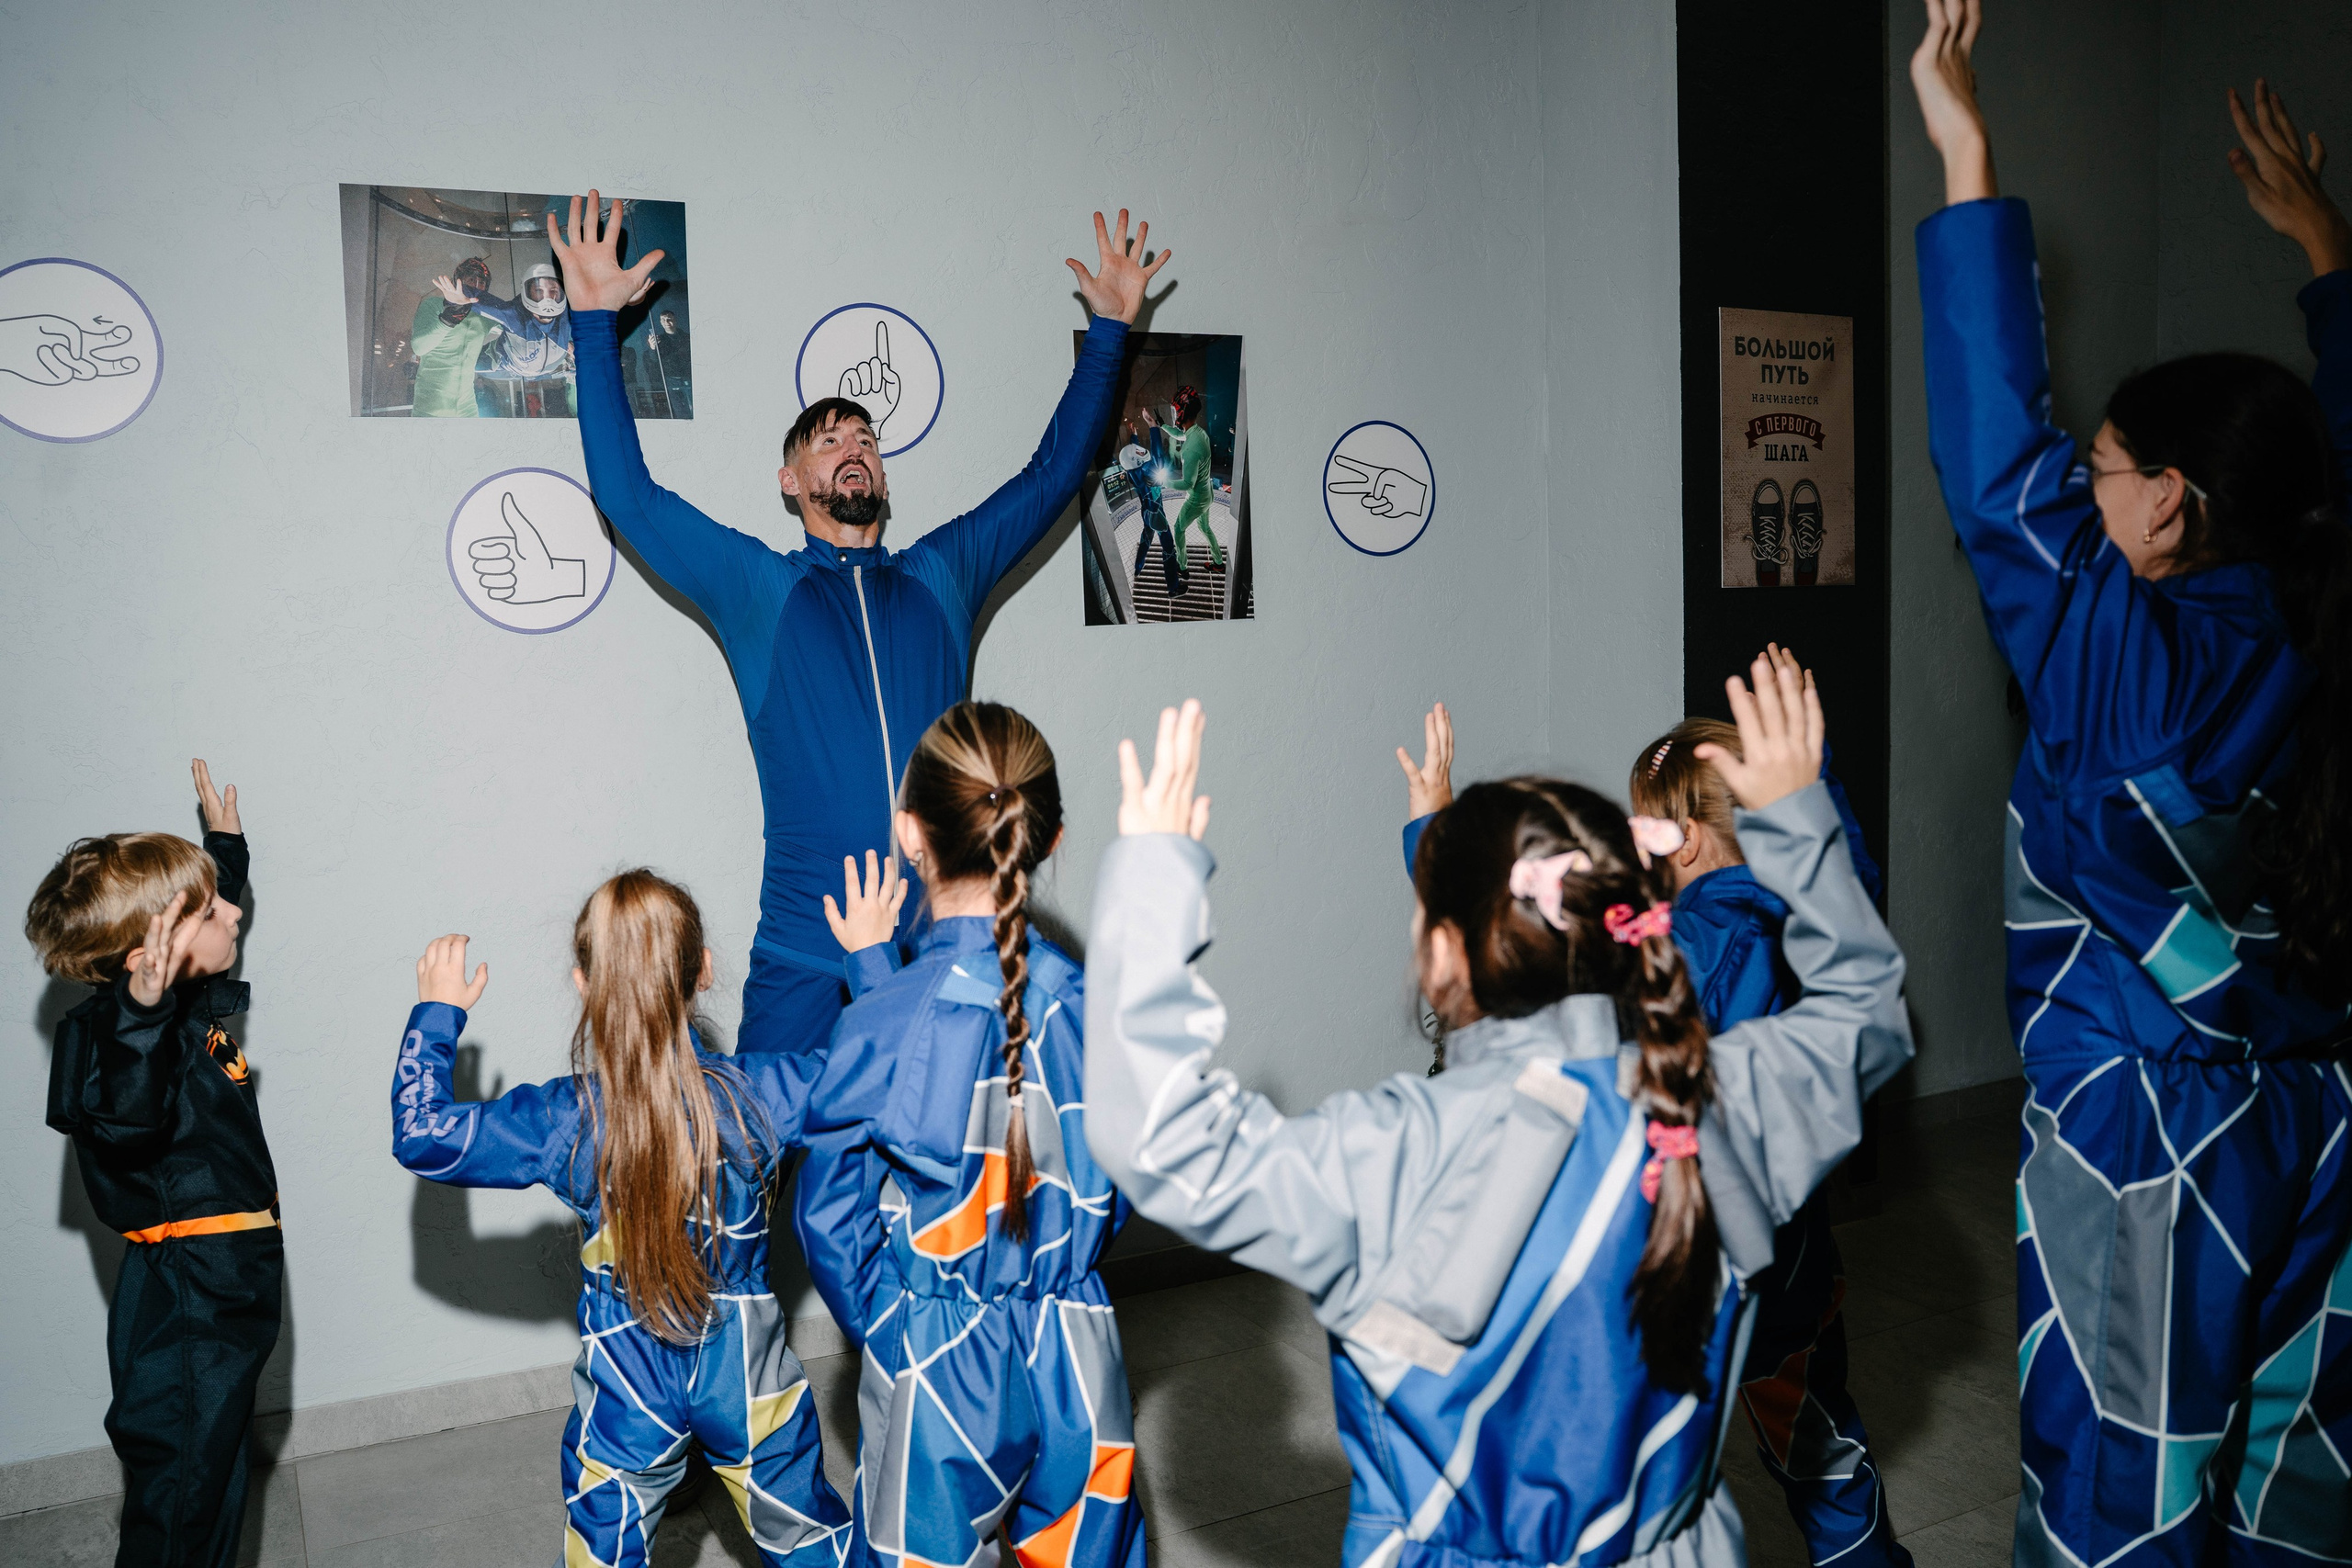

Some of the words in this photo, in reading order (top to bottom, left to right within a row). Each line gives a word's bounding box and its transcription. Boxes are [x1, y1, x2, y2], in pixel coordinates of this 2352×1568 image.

[1735, 336, 1835, 361] БОЛЬШОЙ
[1761, 364, 1809, 385] ПУТЬ
[1751, 392, 1819, 405] начинается
[1755, 421, 1763, 435] С
[1766, 416, 1816, 437] ПЕРВОГО
[1764, 444, 1809, 462] ШАГА
